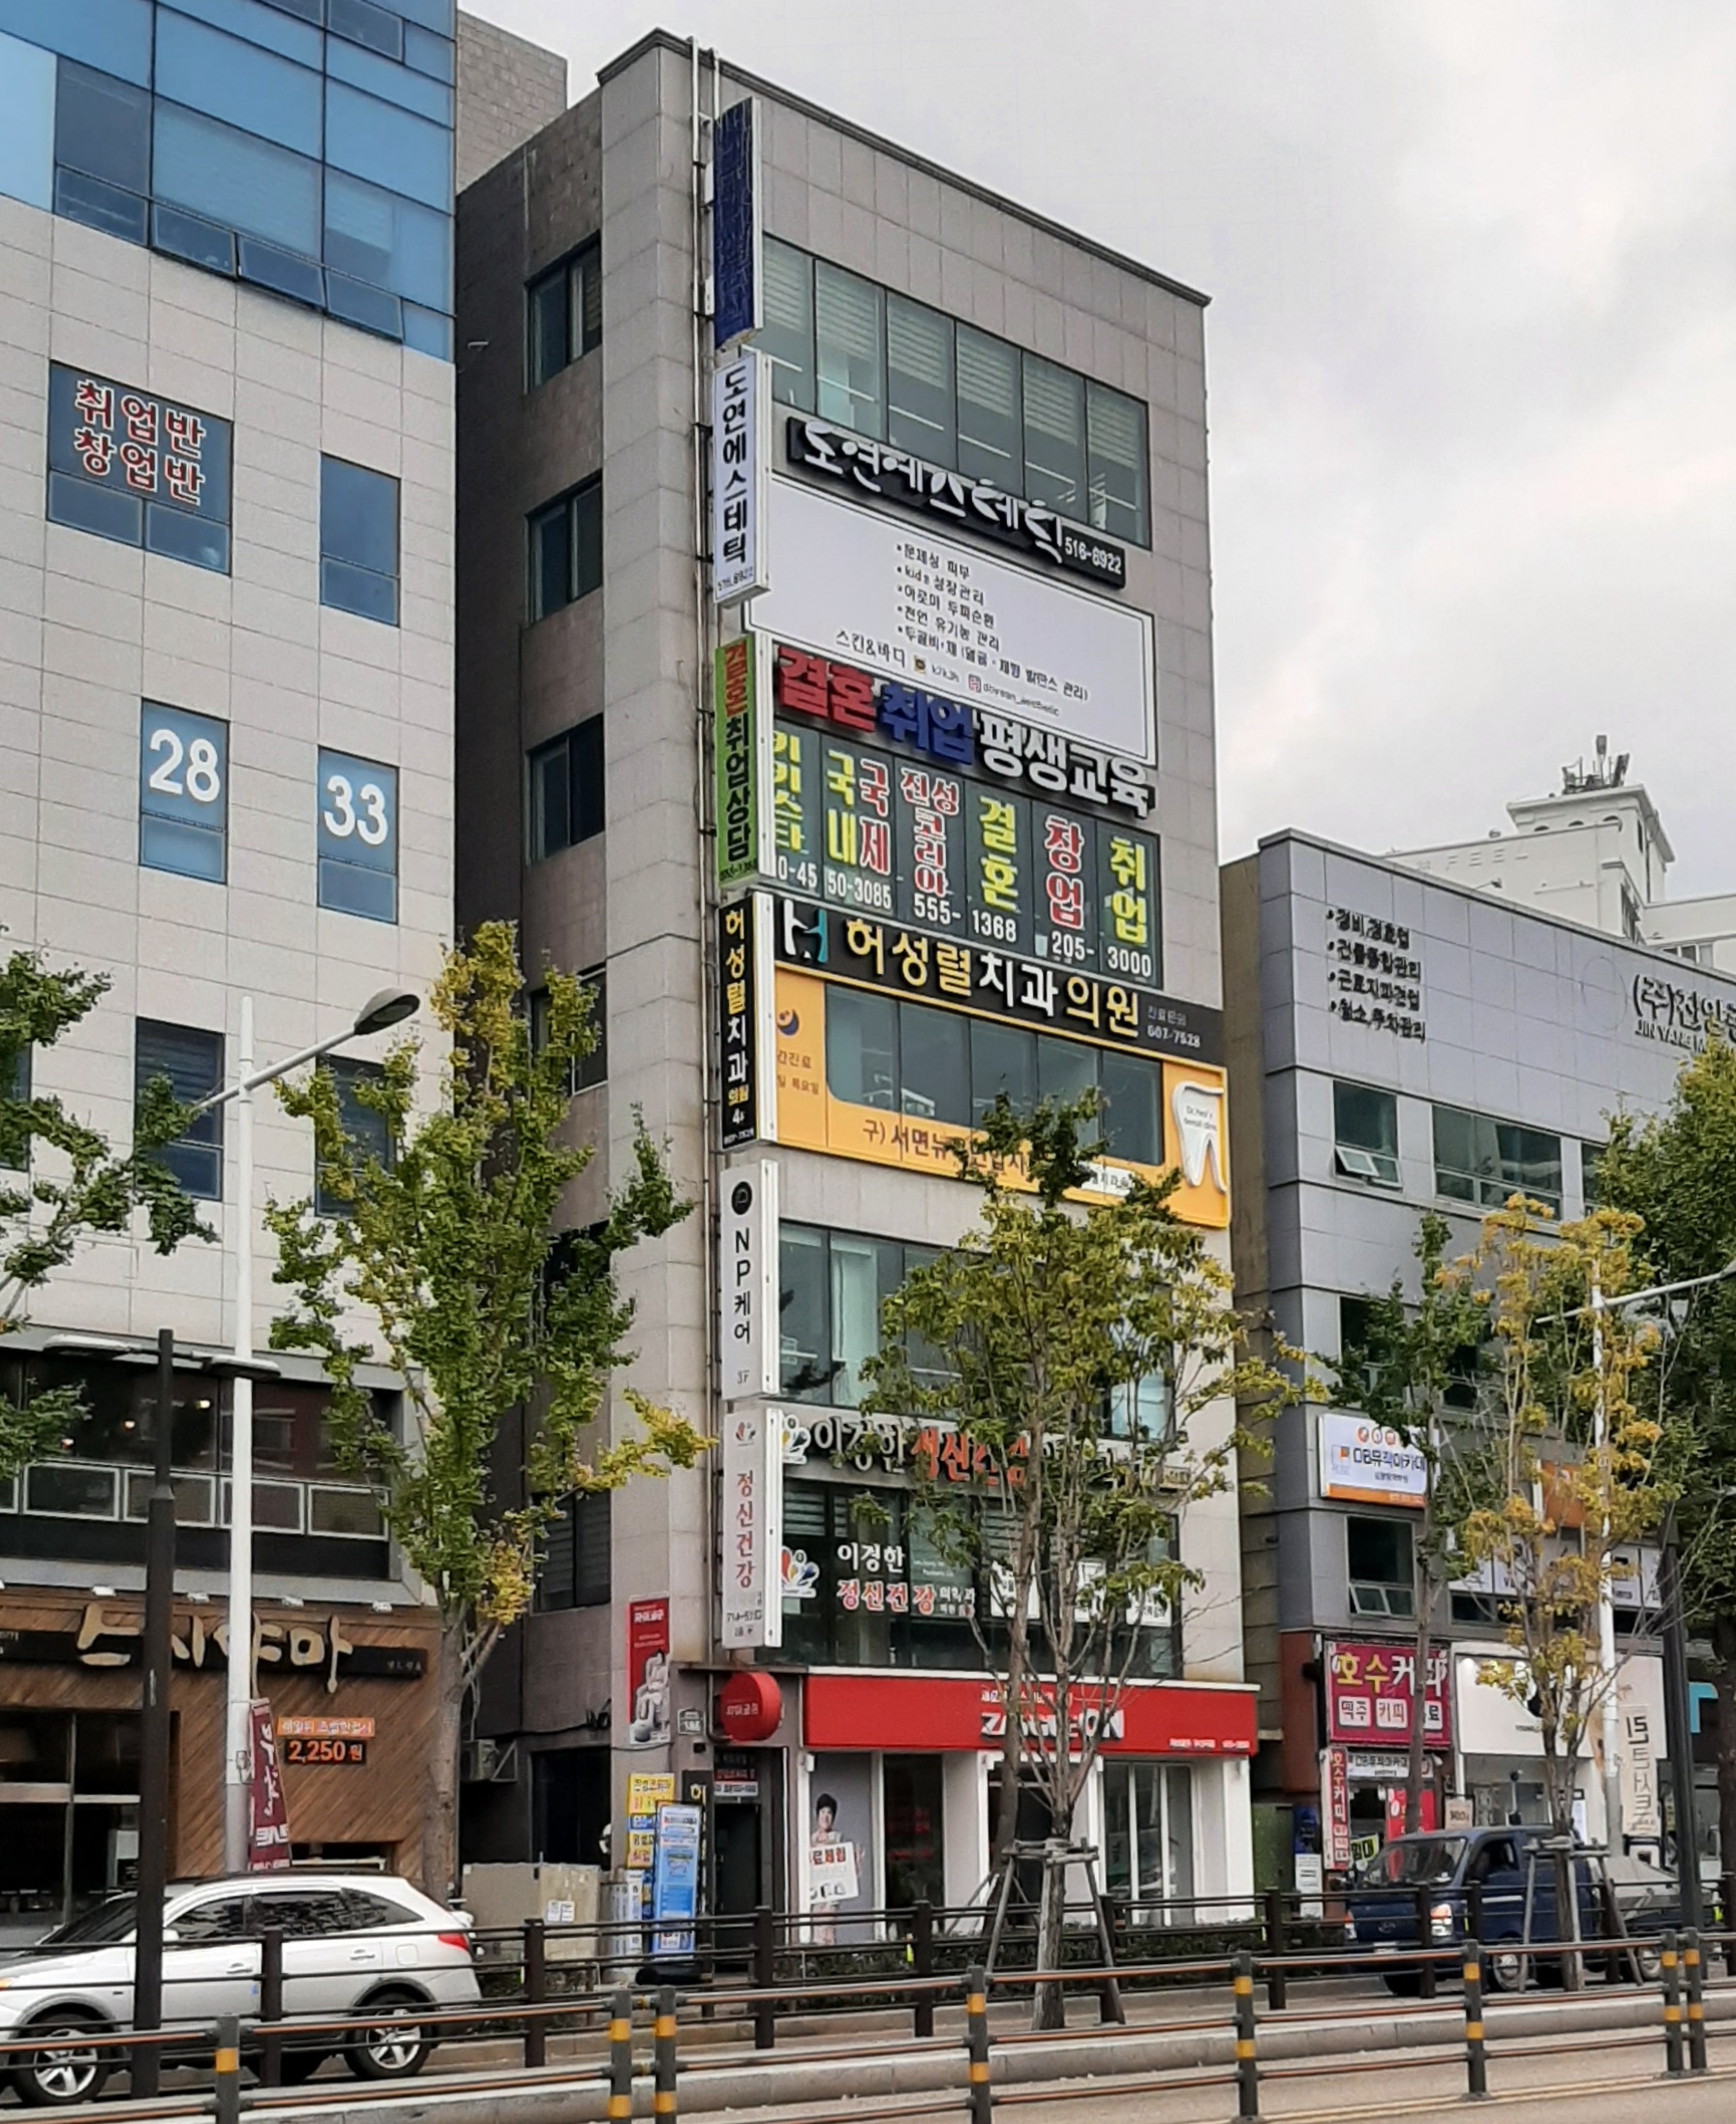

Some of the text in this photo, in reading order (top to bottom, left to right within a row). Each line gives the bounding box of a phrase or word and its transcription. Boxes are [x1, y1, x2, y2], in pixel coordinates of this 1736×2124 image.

[75, 379, 204, 456] 취업반
[75, 427, 204, 505] 창업반
[722, 365, 747, 563] 도연에스테틱
[805, 419, 1062, 563] 도연에스테틱
[148, 729, 220, 802] 28
[878, 682, 974, 765] 취업
[978, 710, 1158, 820] 평생교육
[323, 775, 387, 844] 33
[289, 1741, 346, 1763] 2,250
